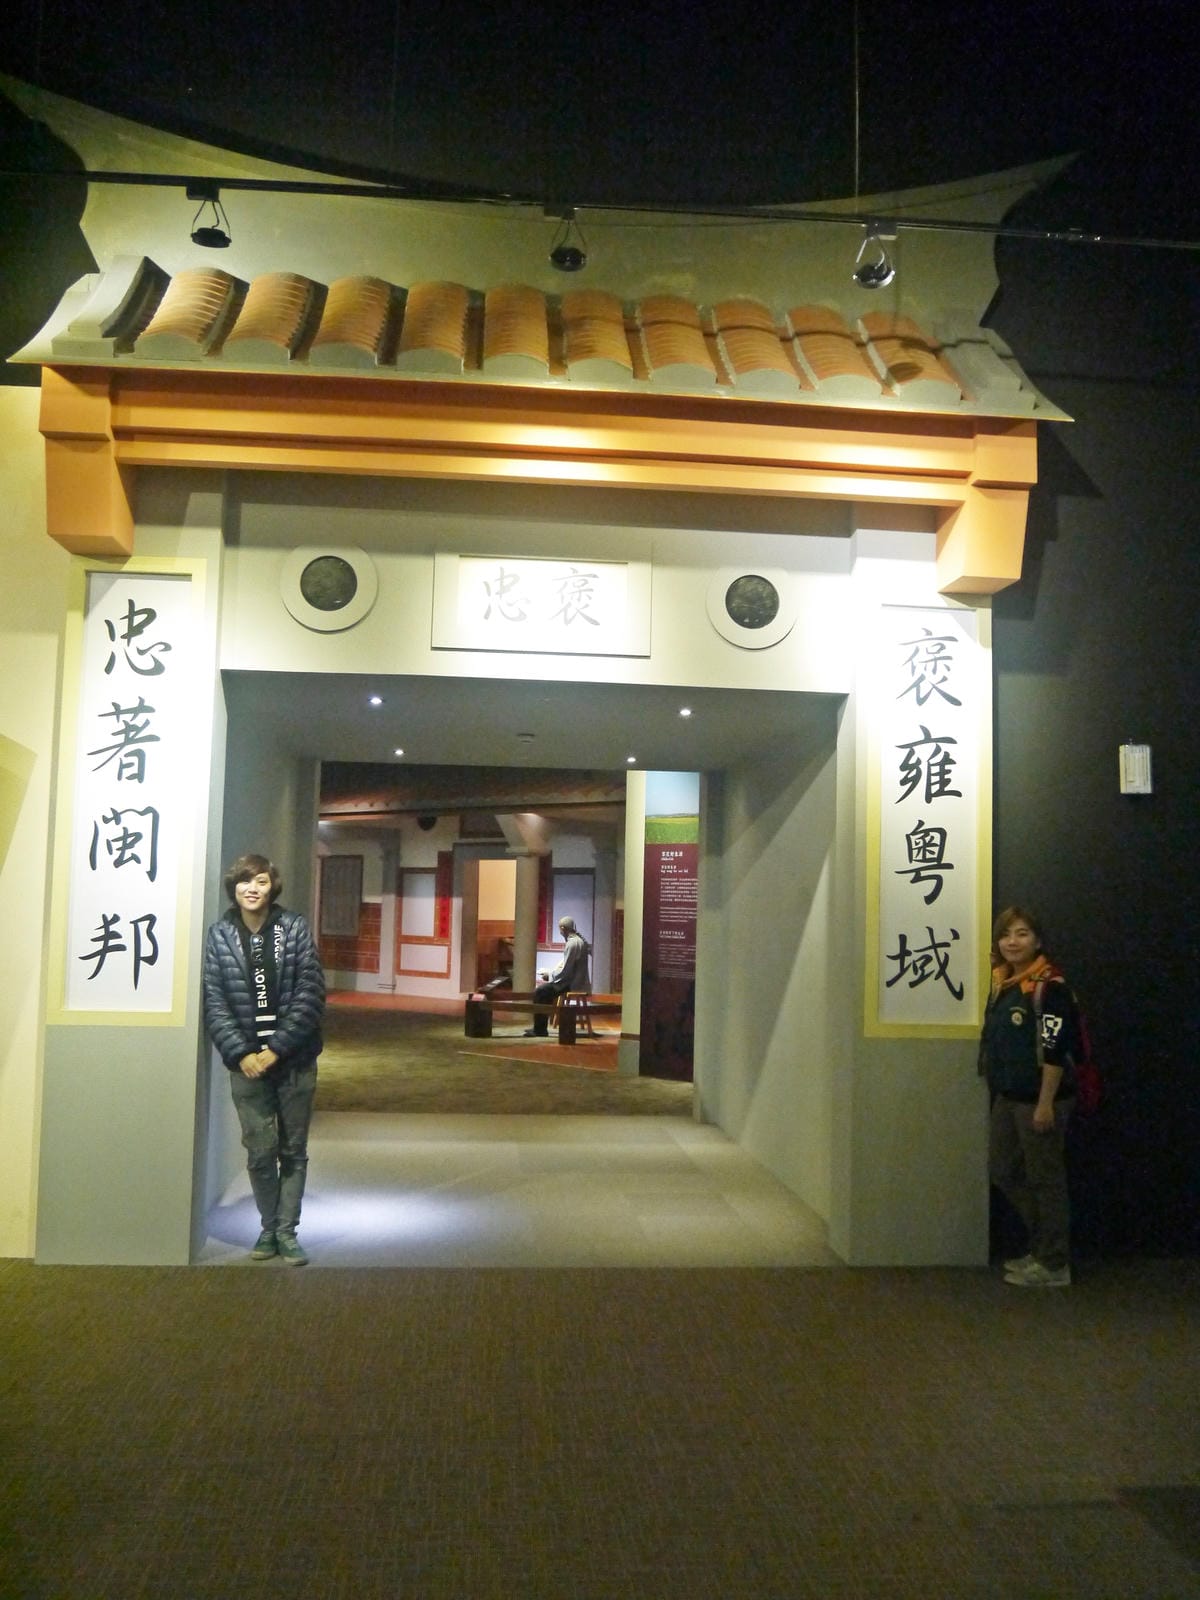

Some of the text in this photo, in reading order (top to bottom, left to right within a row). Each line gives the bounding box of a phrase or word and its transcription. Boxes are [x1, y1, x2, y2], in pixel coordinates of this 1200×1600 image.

[78, 598, 172, 992] 忠著閩邦
[254, 968, 268, 1009] ENJOY
